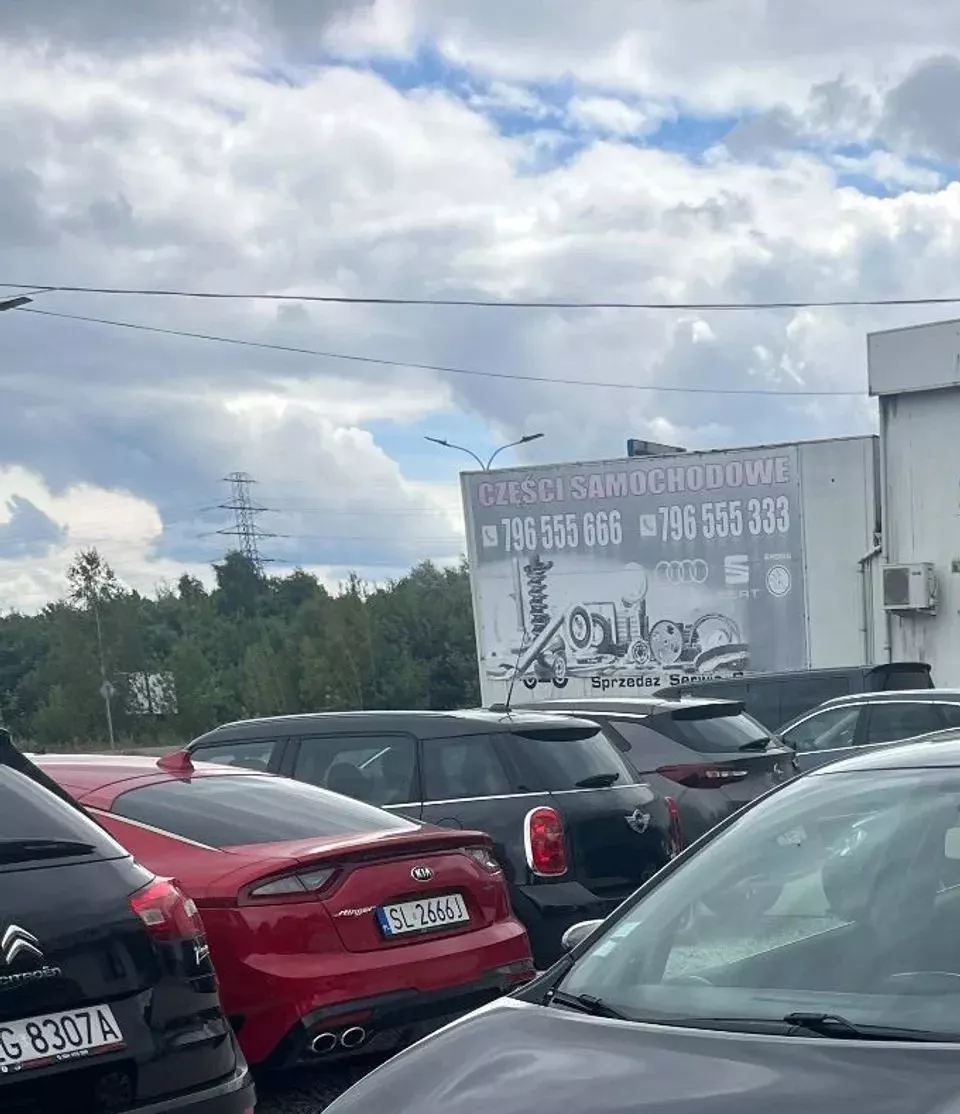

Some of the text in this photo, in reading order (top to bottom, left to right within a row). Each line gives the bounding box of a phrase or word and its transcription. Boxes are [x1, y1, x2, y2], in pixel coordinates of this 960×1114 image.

[478, 457, 790, 508] CZĘŚCI SAMOCHODOWE
[501, 509, 623, 551] 796 555 666
[657, 496, 790, 542] 796 555 333
[415, 868, 431, 878] KIA
[390, 897, 463, 930] SL 2666J
[0, 1010, 119, 1062] G 8307A
